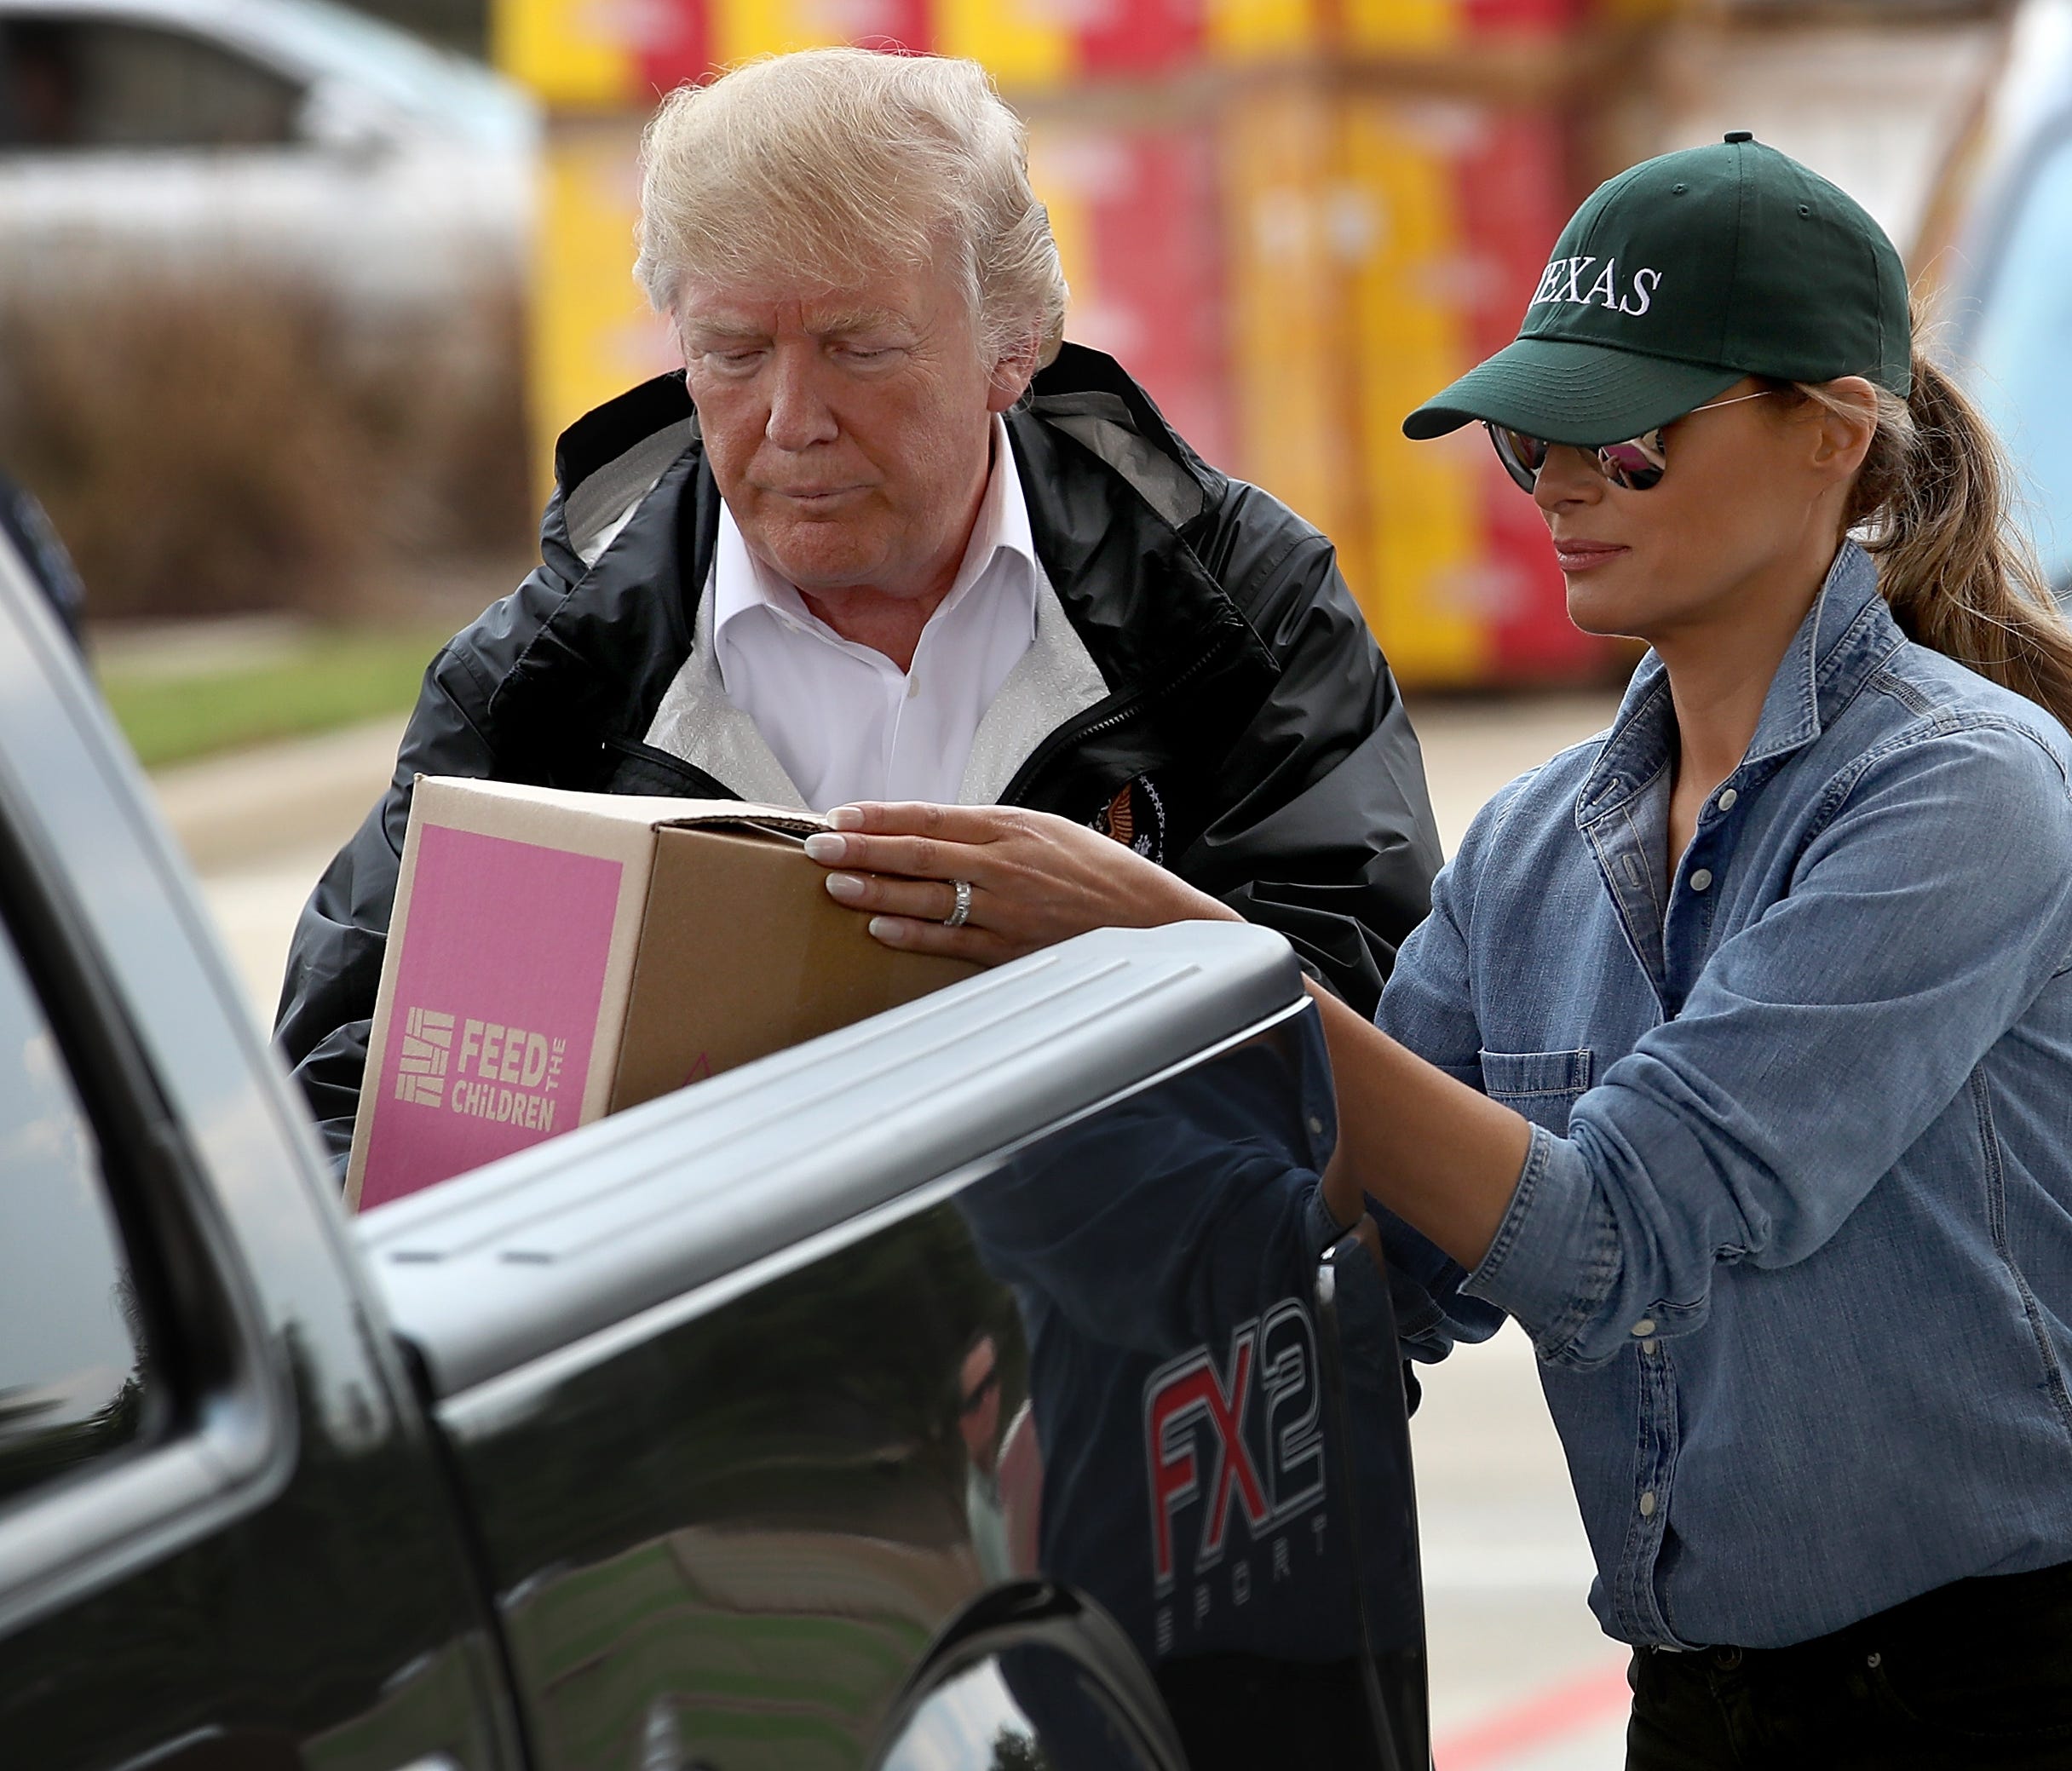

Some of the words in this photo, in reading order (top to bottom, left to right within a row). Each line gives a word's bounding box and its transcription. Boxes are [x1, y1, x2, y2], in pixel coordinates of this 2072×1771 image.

[1528, 256, 1662, 316] EXAS
[457, 1018, 548, 1088] FEED
[544, 1036, 566, 1092] THE
[1142, 1297, 1326, 1600] FX2
[1154, 1513, 1327, 1656] SPORT
